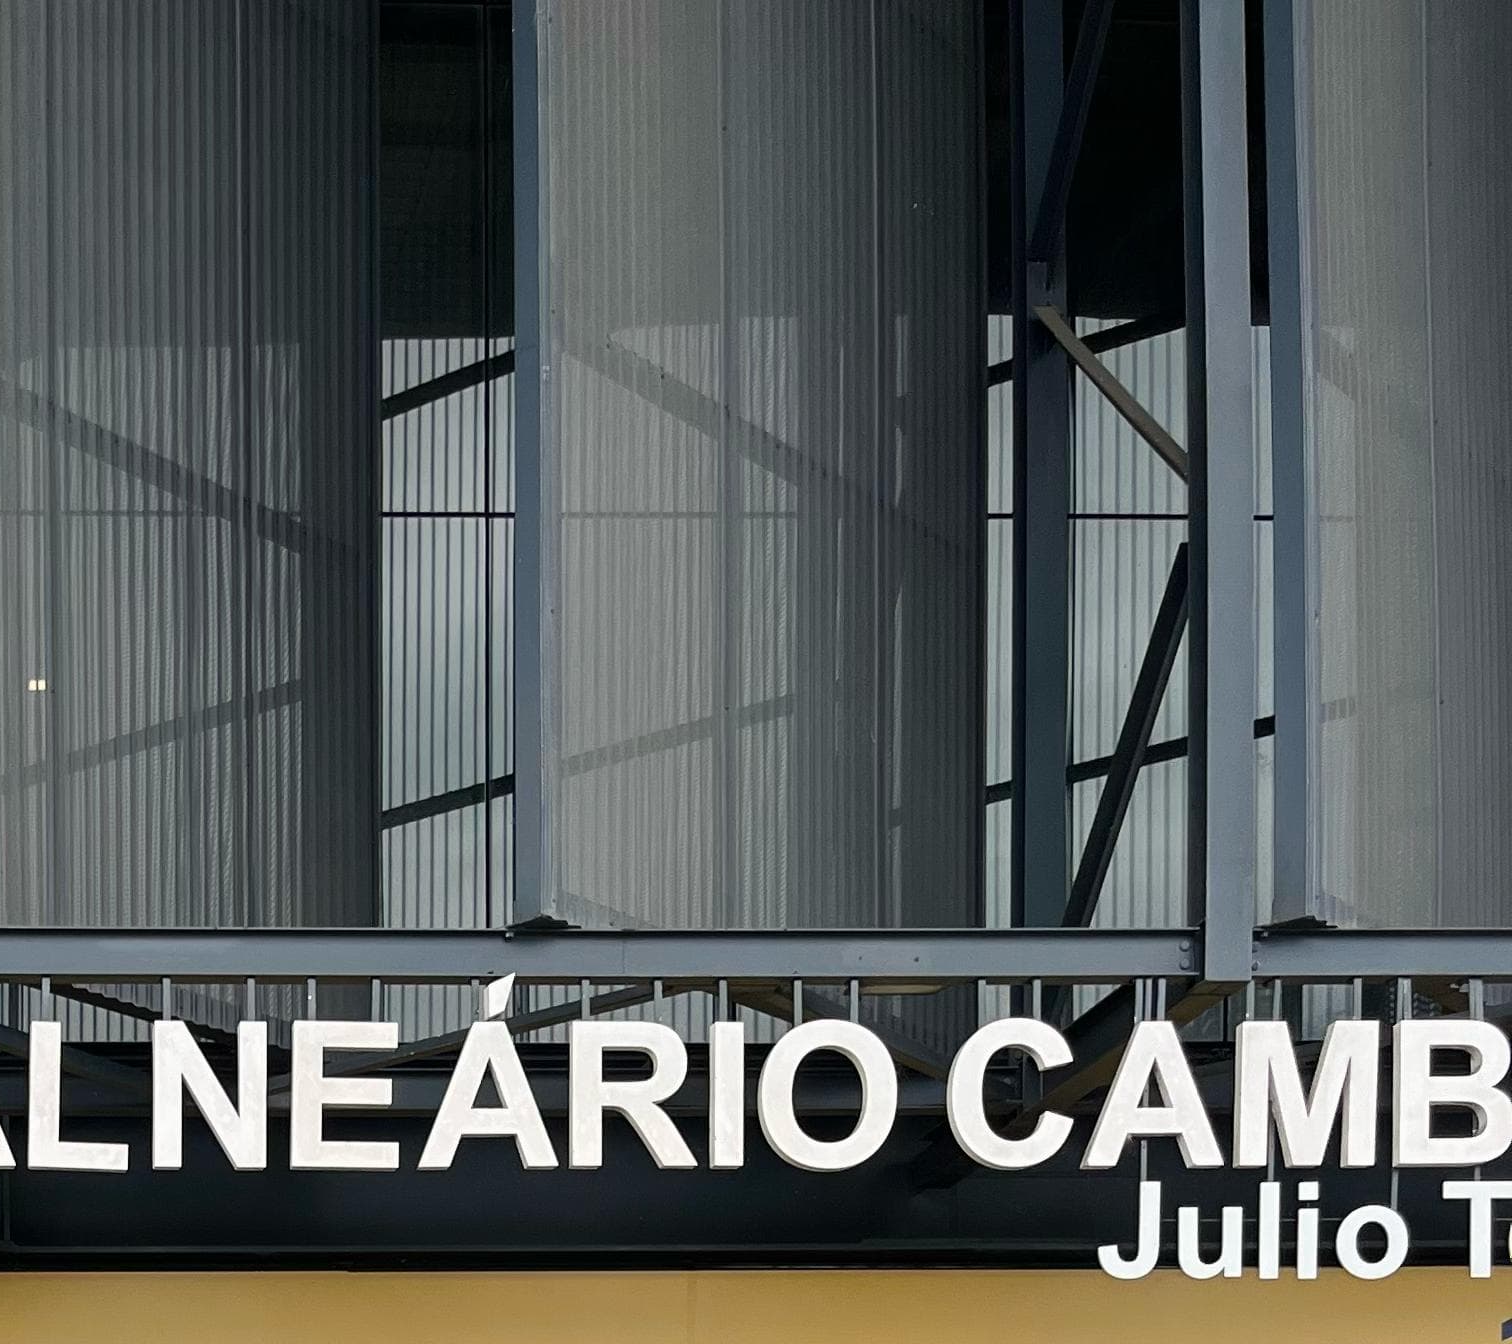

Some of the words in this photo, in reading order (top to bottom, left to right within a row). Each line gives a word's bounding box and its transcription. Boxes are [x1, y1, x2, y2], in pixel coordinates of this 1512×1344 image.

[946, 1015, 1512, 1171] CAMB
[1097, 1180, 1410, 1281] Julio
[1441, 1180, 1512, 1279] T
